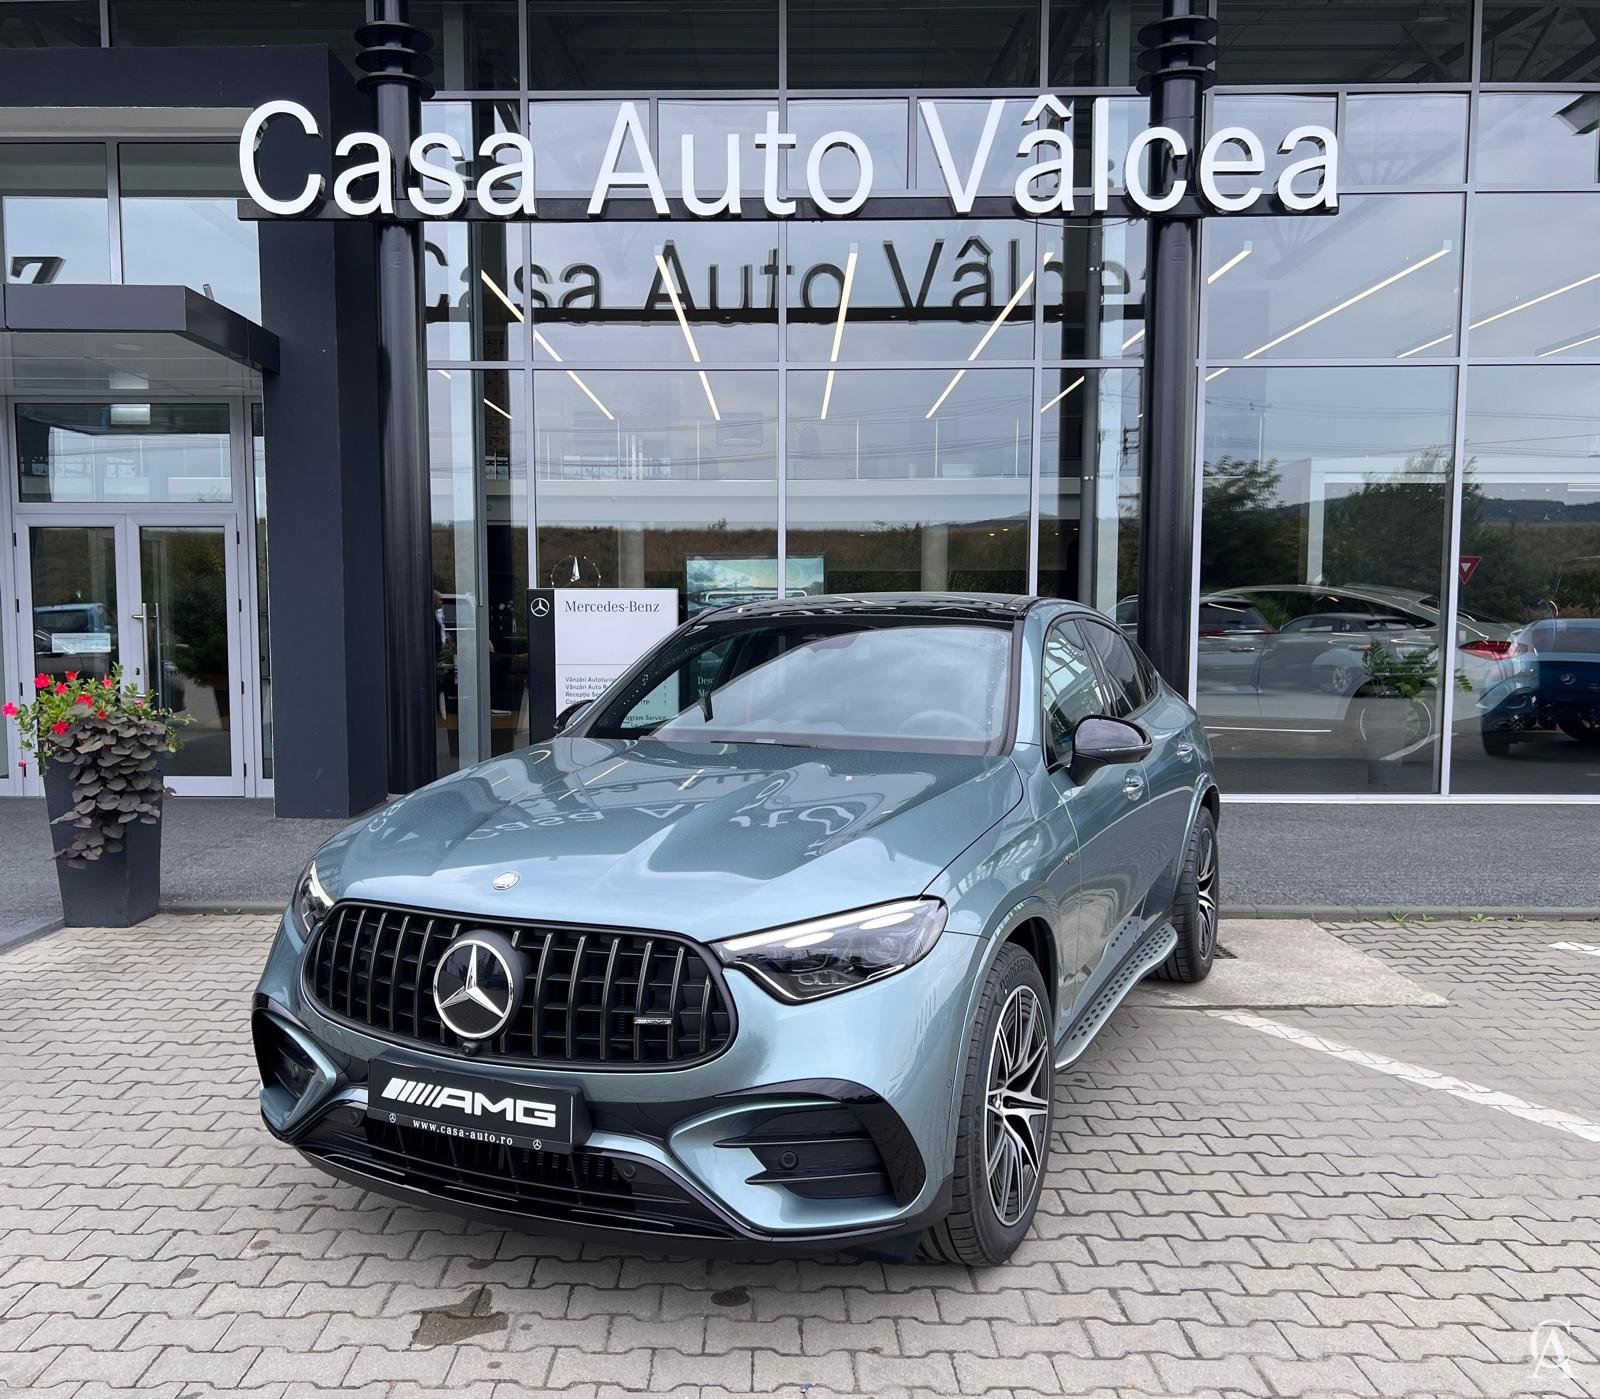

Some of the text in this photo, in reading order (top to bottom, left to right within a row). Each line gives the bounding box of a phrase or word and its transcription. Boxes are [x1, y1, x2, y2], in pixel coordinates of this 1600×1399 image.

[239, 94, 1338, 217] Casa Auto Vâlcea
[565, 600, 660, 613] Mercedes-Benz
[431, 1087, 556, 1128] AMG
[412, 1119, 513, 1146] www.casa-auto.ro
